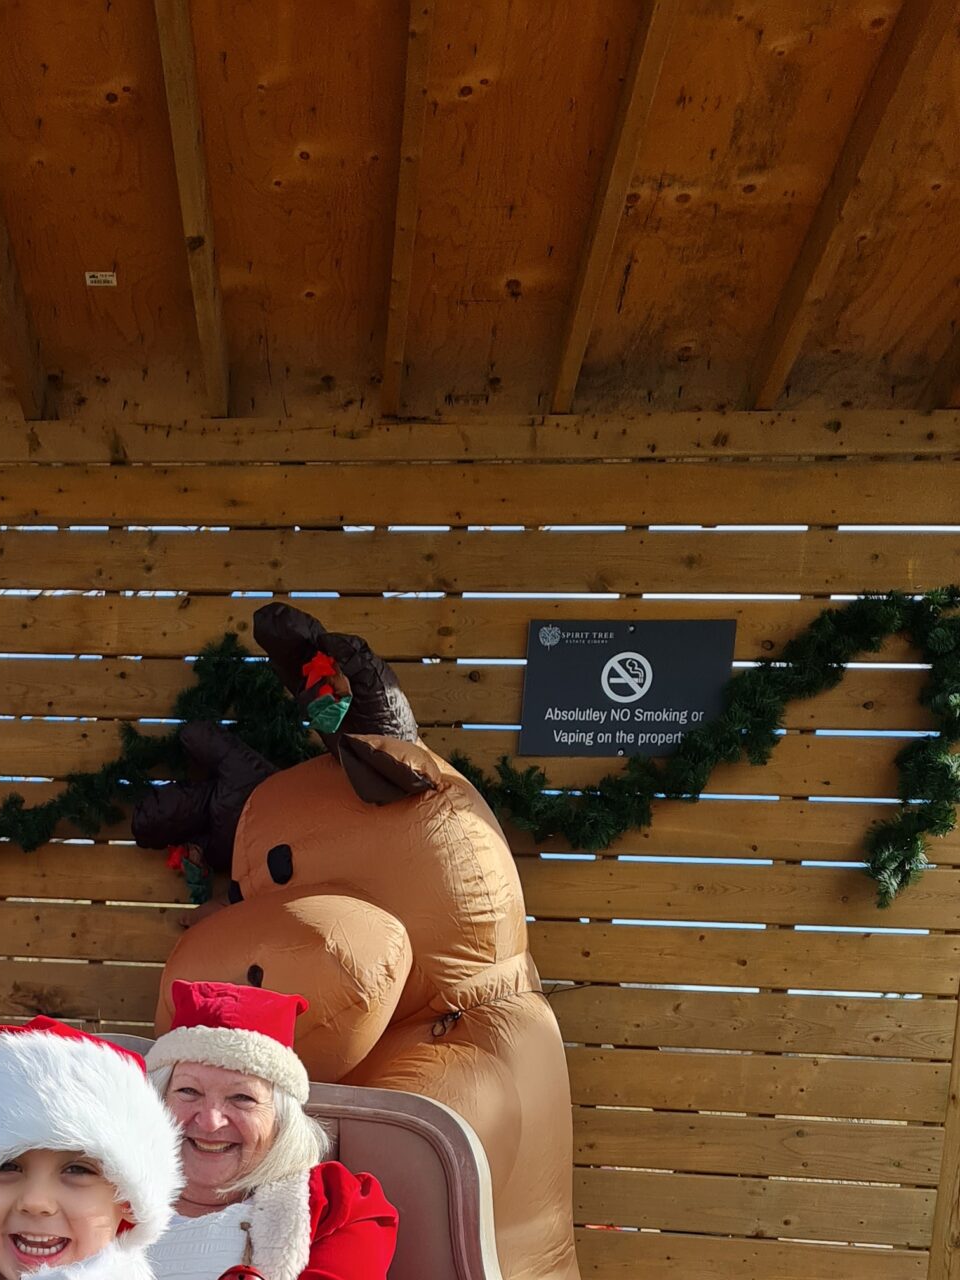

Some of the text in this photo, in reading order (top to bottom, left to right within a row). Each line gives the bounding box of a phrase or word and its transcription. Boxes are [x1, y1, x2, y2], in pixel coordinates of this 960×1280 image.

[561, 631, 615, 639] SPIRIT TREE
[544, 707, 705, 725] Absolutley NO Smoking or
[553, 729, 684, 746] Vaping on the propert
